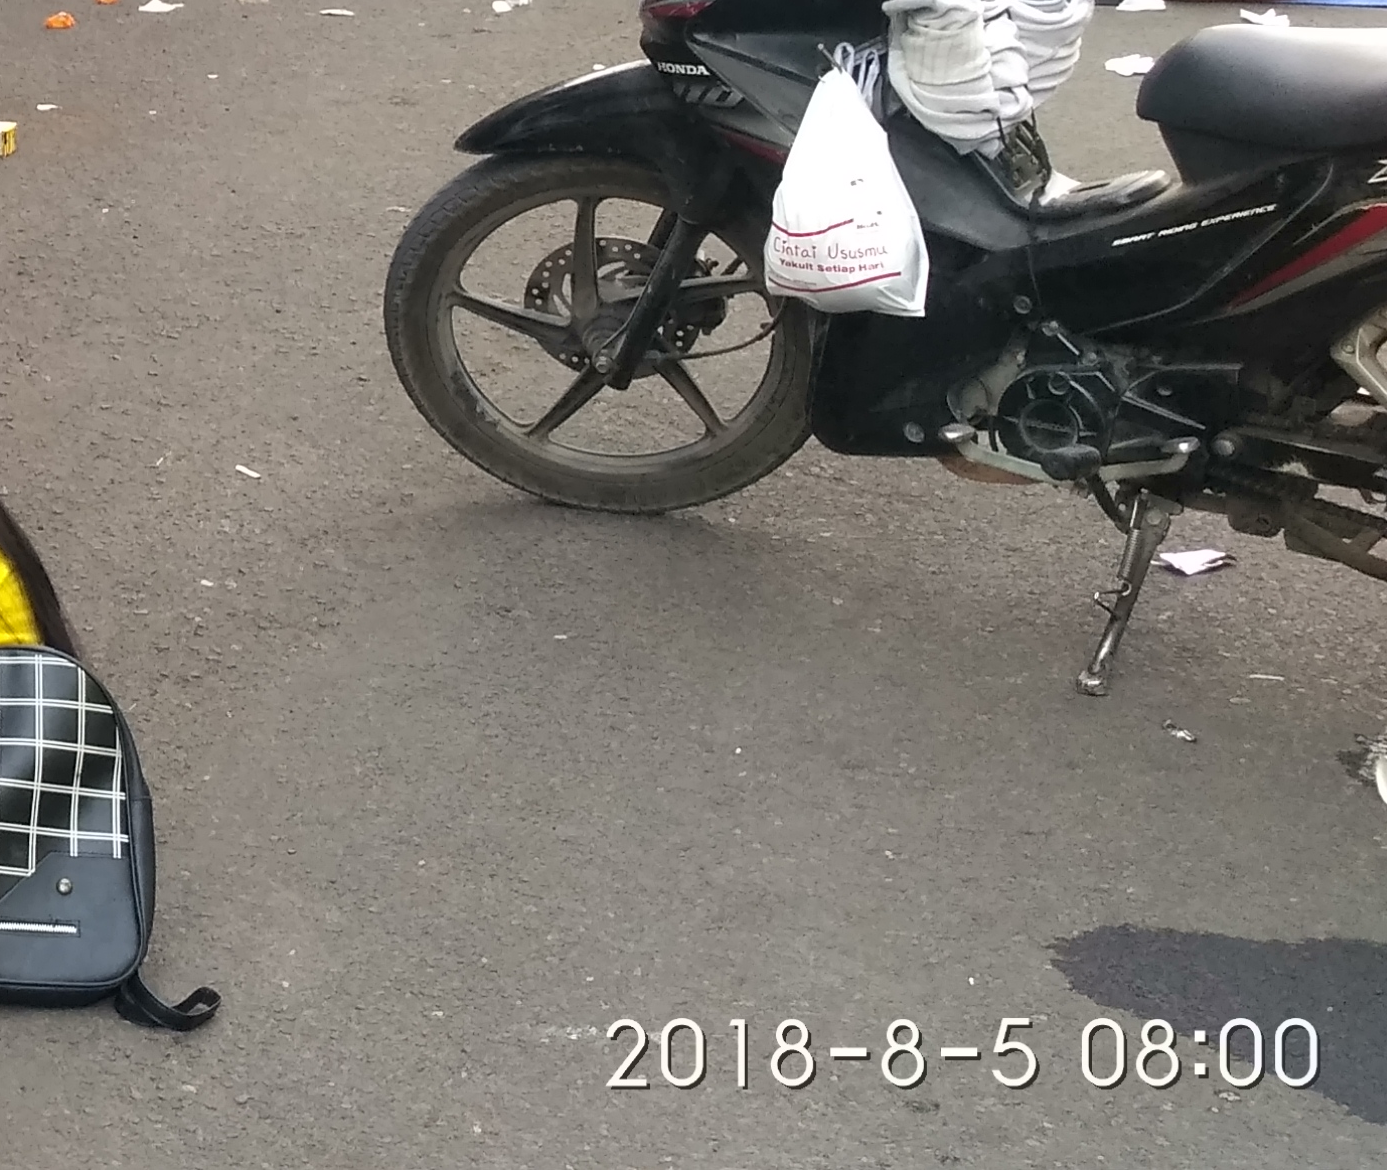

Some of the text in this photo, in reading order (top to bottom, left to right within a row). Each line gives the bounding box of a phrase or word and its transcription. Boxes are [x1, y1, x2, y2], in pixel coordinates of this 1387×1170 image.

[657, 61, 711, 77] HONDA
[1201, 203, 1279, 228] EXPERIENCE
[773, 236, 889, 261] Cintai Ususmu
[779, 258, 884, 274] Yakult Setiap Hari
